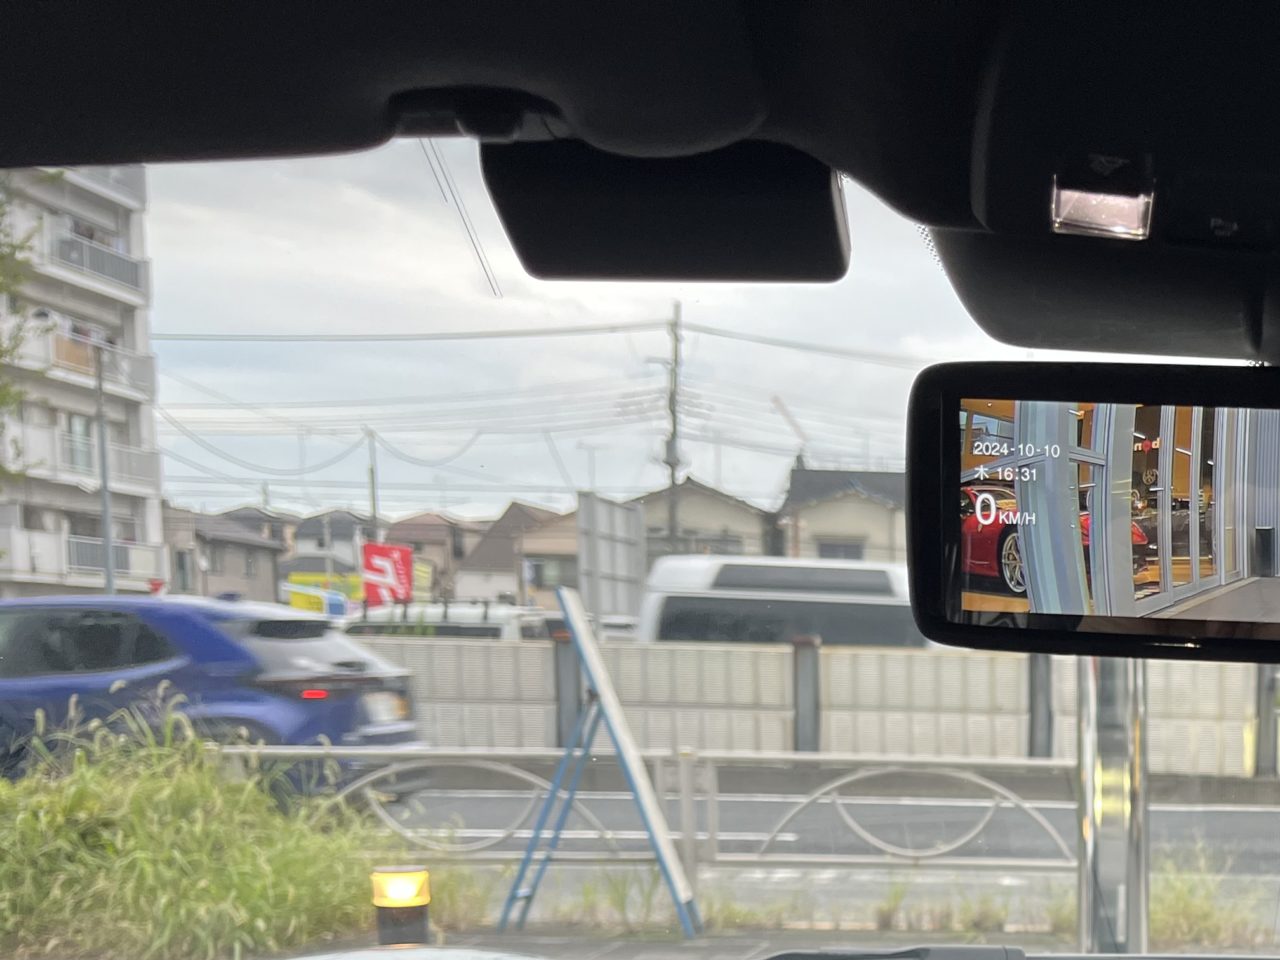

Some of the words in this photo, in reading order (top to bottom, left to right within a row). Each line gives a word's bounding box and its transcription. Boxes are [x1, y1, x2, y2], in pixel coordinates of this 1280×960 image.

[973, 441, 1061, 459] 2024-10-10
[974, 466, 990, 481] 木
[996, 467, 1038, 482] 16:31
[975, 493, 997, 525] 0
[999, 511, 1036, 527] KM/H
